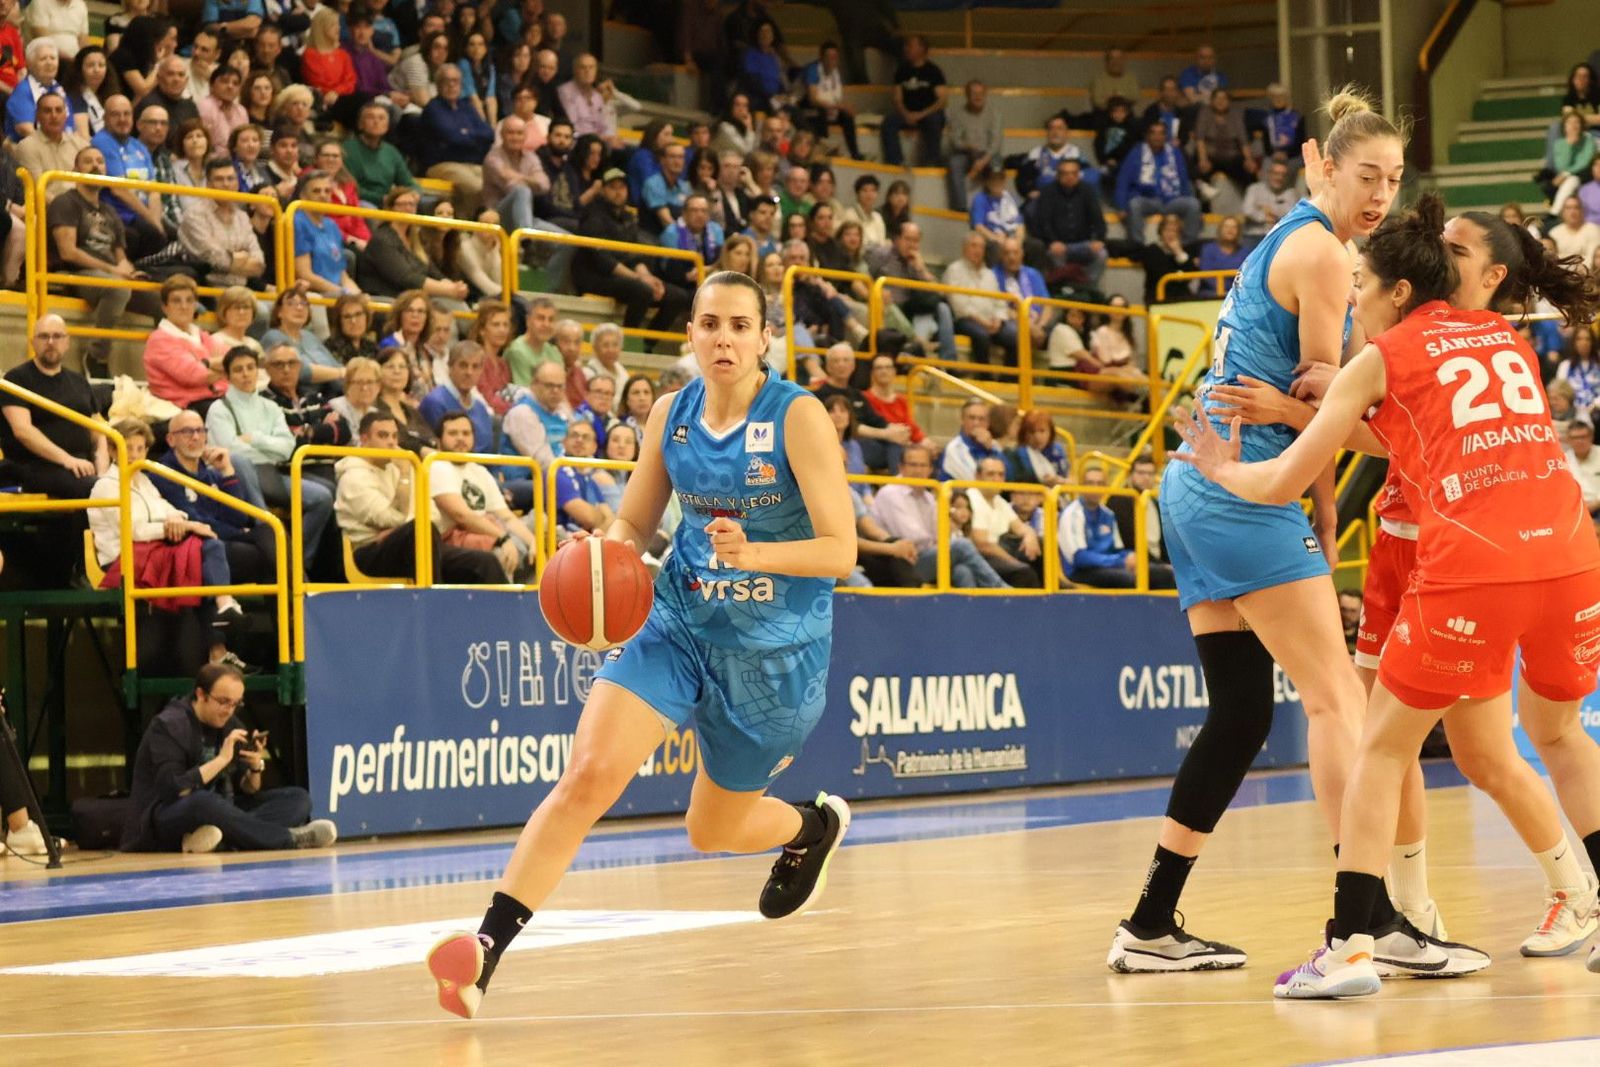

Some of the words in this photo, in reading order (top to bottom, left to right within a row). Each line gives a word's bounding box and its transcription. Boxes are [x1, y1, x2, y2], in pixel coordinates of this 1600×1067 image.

[1425, 331, 1516, 358] SÁNCHEZ
[1436, 350, 1545, 430] 28
[1463, 463, 1503, 481] XUNTA
[1465, 479, 1480, 493] DE
[1483, 470, 1529, 488] GALICIA
[727, 498, 736, 510] Y
[742, 491, 782, 509] LEÓN
[849, 672, 1027, 738] SALAMANCA
[951, 748, 962, 770] de
[963, 748, 972, 769] la
